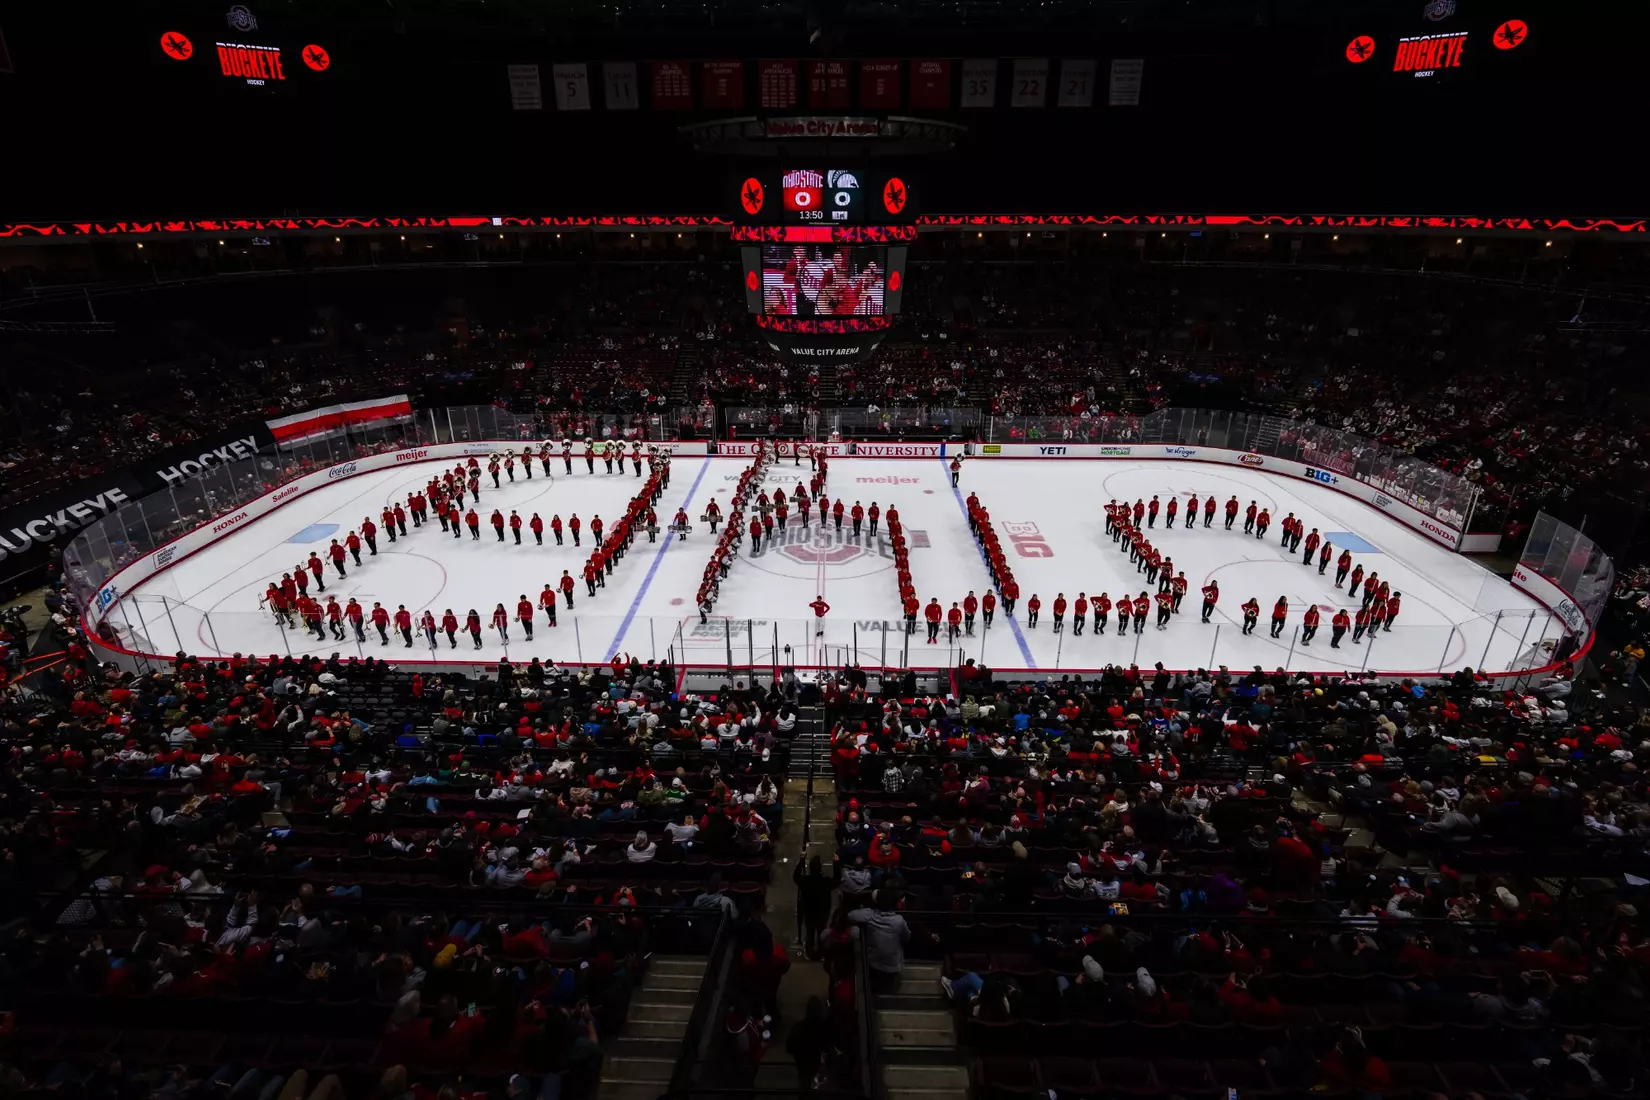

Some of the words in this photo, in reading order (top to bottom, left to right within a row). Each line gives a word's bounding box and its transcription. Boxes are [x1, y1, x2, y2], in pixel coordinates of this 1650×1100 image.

[1392, 32, 1469, 72] BUCKEYE
[216, 43, 286, 80] BUCKEYE
[1414, 70, 1435, 78] HOCKEY
[566, 82, 576, 98] 5
[968, 80, 988, 96] 35
[1019, 80, 1040, 96] 22
[1067, 80, 1087, 96] 21
[767, 120, 805, 134] Value
[806, 120, 835, 137] City
[836, 120, 877, 134] Arena
[795, 191, 811, 206] 0
[834, 191, 851, 206] 0
[799, 210, 823, 220] 13:50
[791, 347, 815, 356] VALUE
[816, 348, 835, 356] CITY
[836, 346, 860, 356] ARENA
[395, 448, 429, 462] meijer
[717, 443, 746, 455] THE
[1039, 446, 1067, 455] YETI
[1174, 447, 1196, 458] Kroger
[157, 435, 261, 486] HOCKEY
[855, 475, 921, 485] meijer
[271, 485, 299, 504] Safelite
[212, 511, 248, 534] HONDA
[1001, 521, 1055, 558] BIG
[1420, 519, 1457, 544] HONDA
